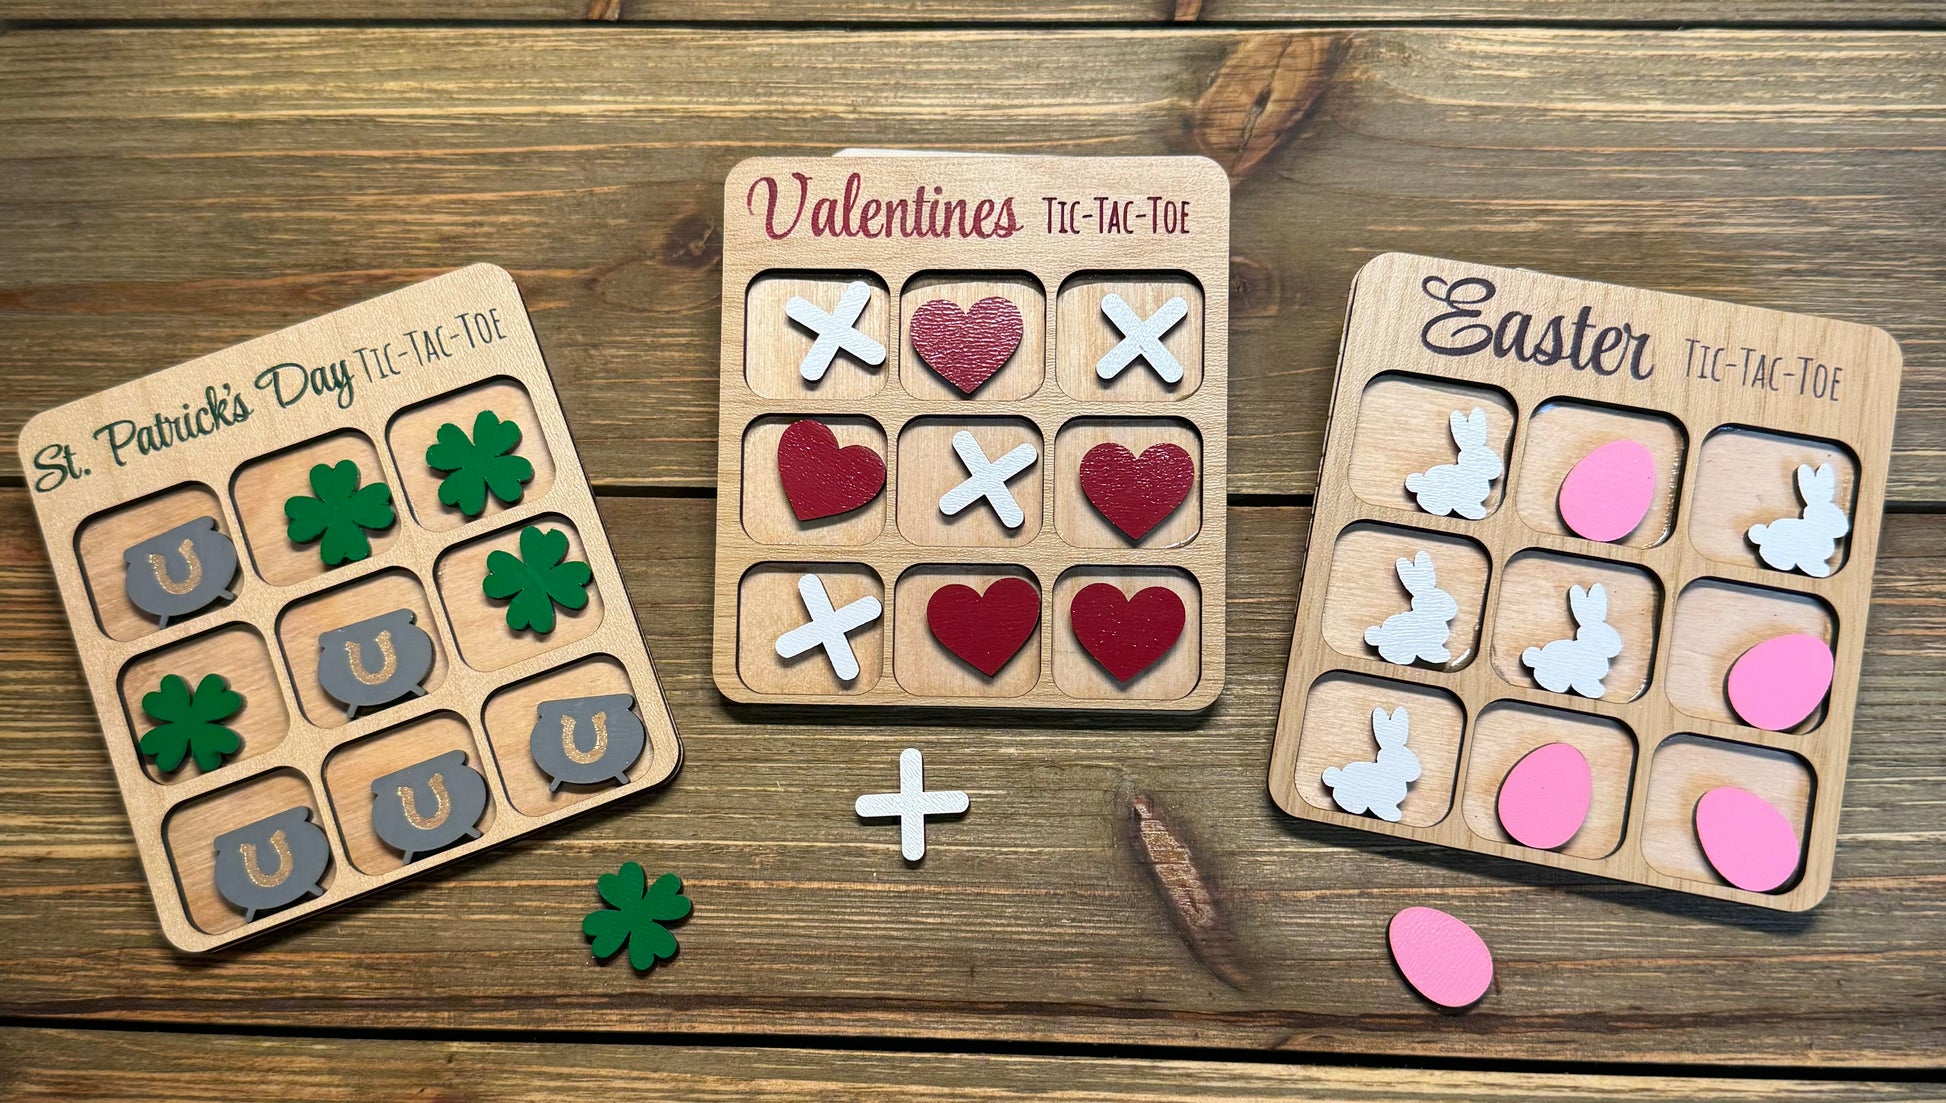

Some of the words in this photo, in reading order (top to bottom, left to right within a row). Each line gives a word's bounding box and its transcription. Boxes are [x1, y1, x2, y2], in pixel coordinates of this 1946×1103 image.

[746, 172, 1024, 240] Valentines
[1421, 275, 1654, 381] Easter
[33, 443, 92, 493] St.
[93, 383, 254, 467] Patrick's
[254, 359, 355, 409] Day
